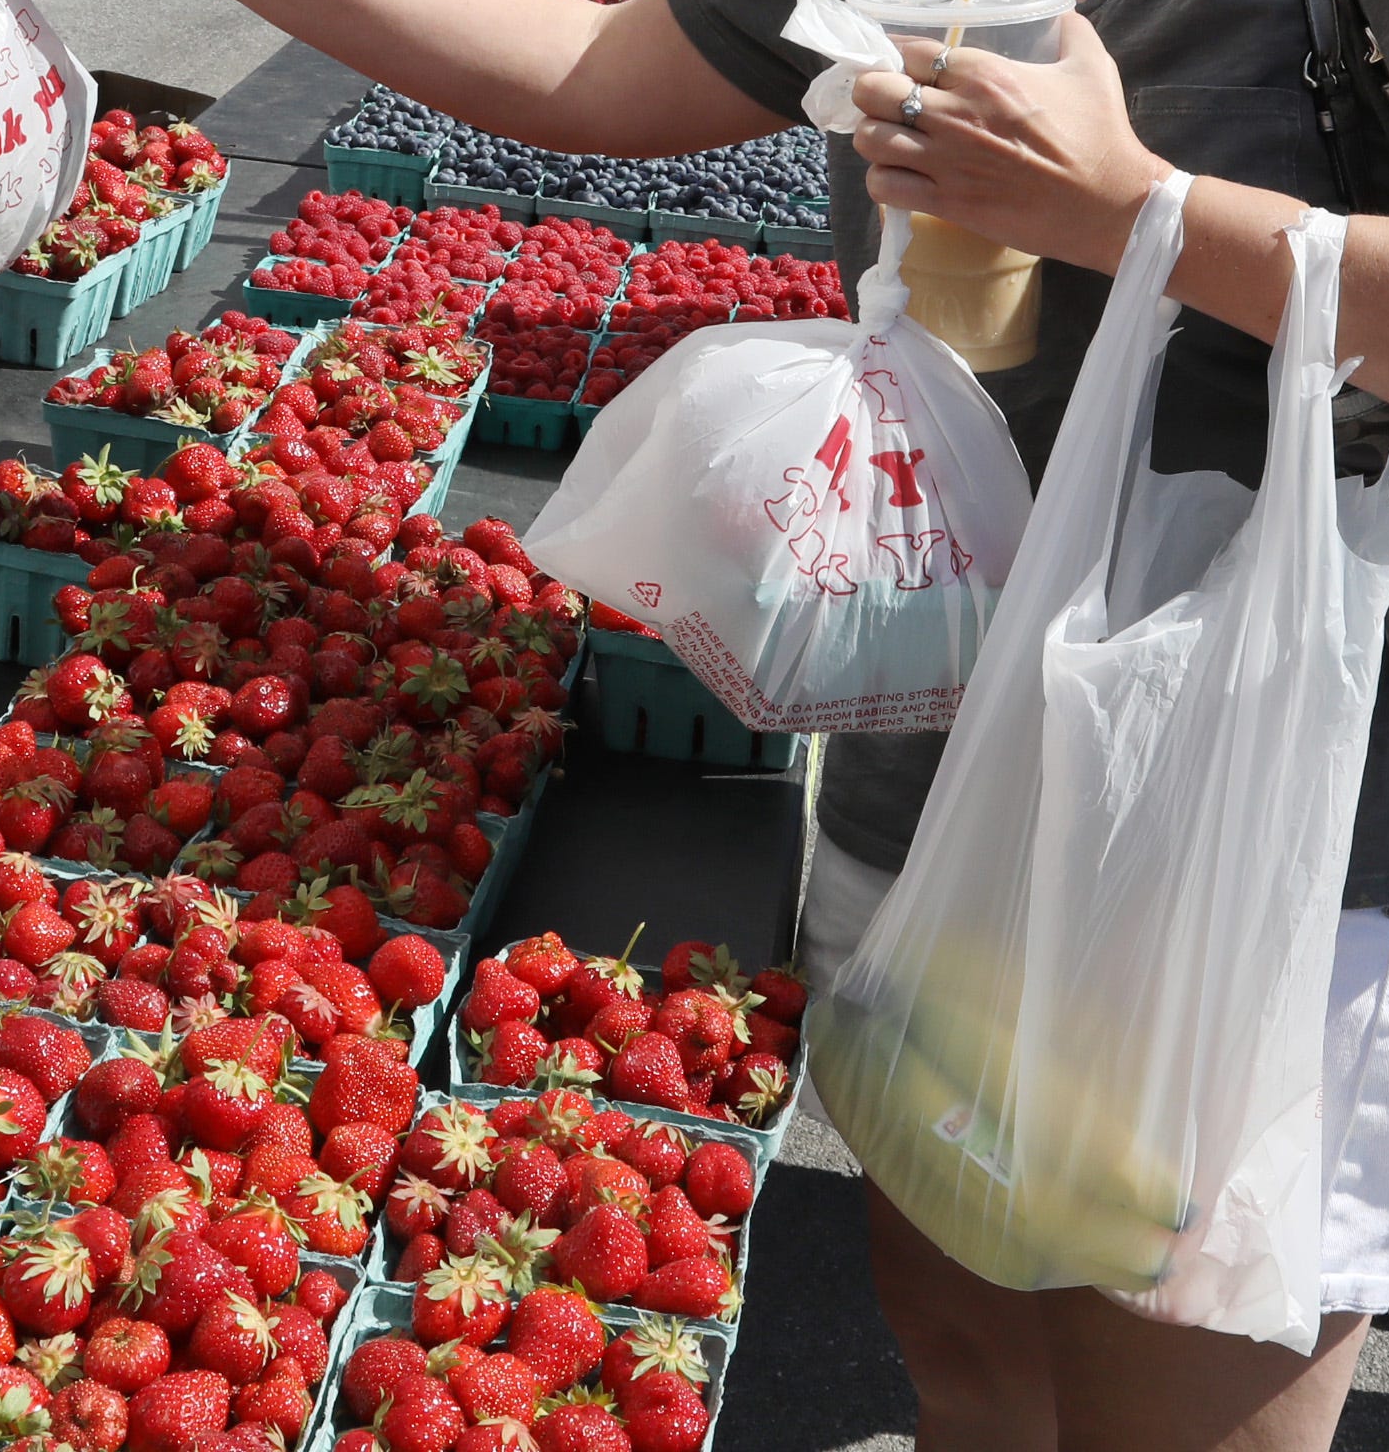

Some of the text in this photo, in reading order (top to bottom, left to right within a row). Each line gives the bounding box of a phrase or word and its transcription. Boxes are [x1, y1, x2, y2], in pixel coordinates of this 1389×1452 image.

[690, 610, 725, 651] PLEASE
[803, 704, 812, 713] A
[814, 692, 905, 712] PARTICIPATING
[907, 687, 948, 701] STORE
[720, 667, 745, 695] KEEP
[777, 714, 813, 727] AWAY
[815, 711, 851, 723] FROM
[854, 704, 899, 719] BABIES
[900, 702, 926, 714] AND
[914, 714, 938, 725] THE
